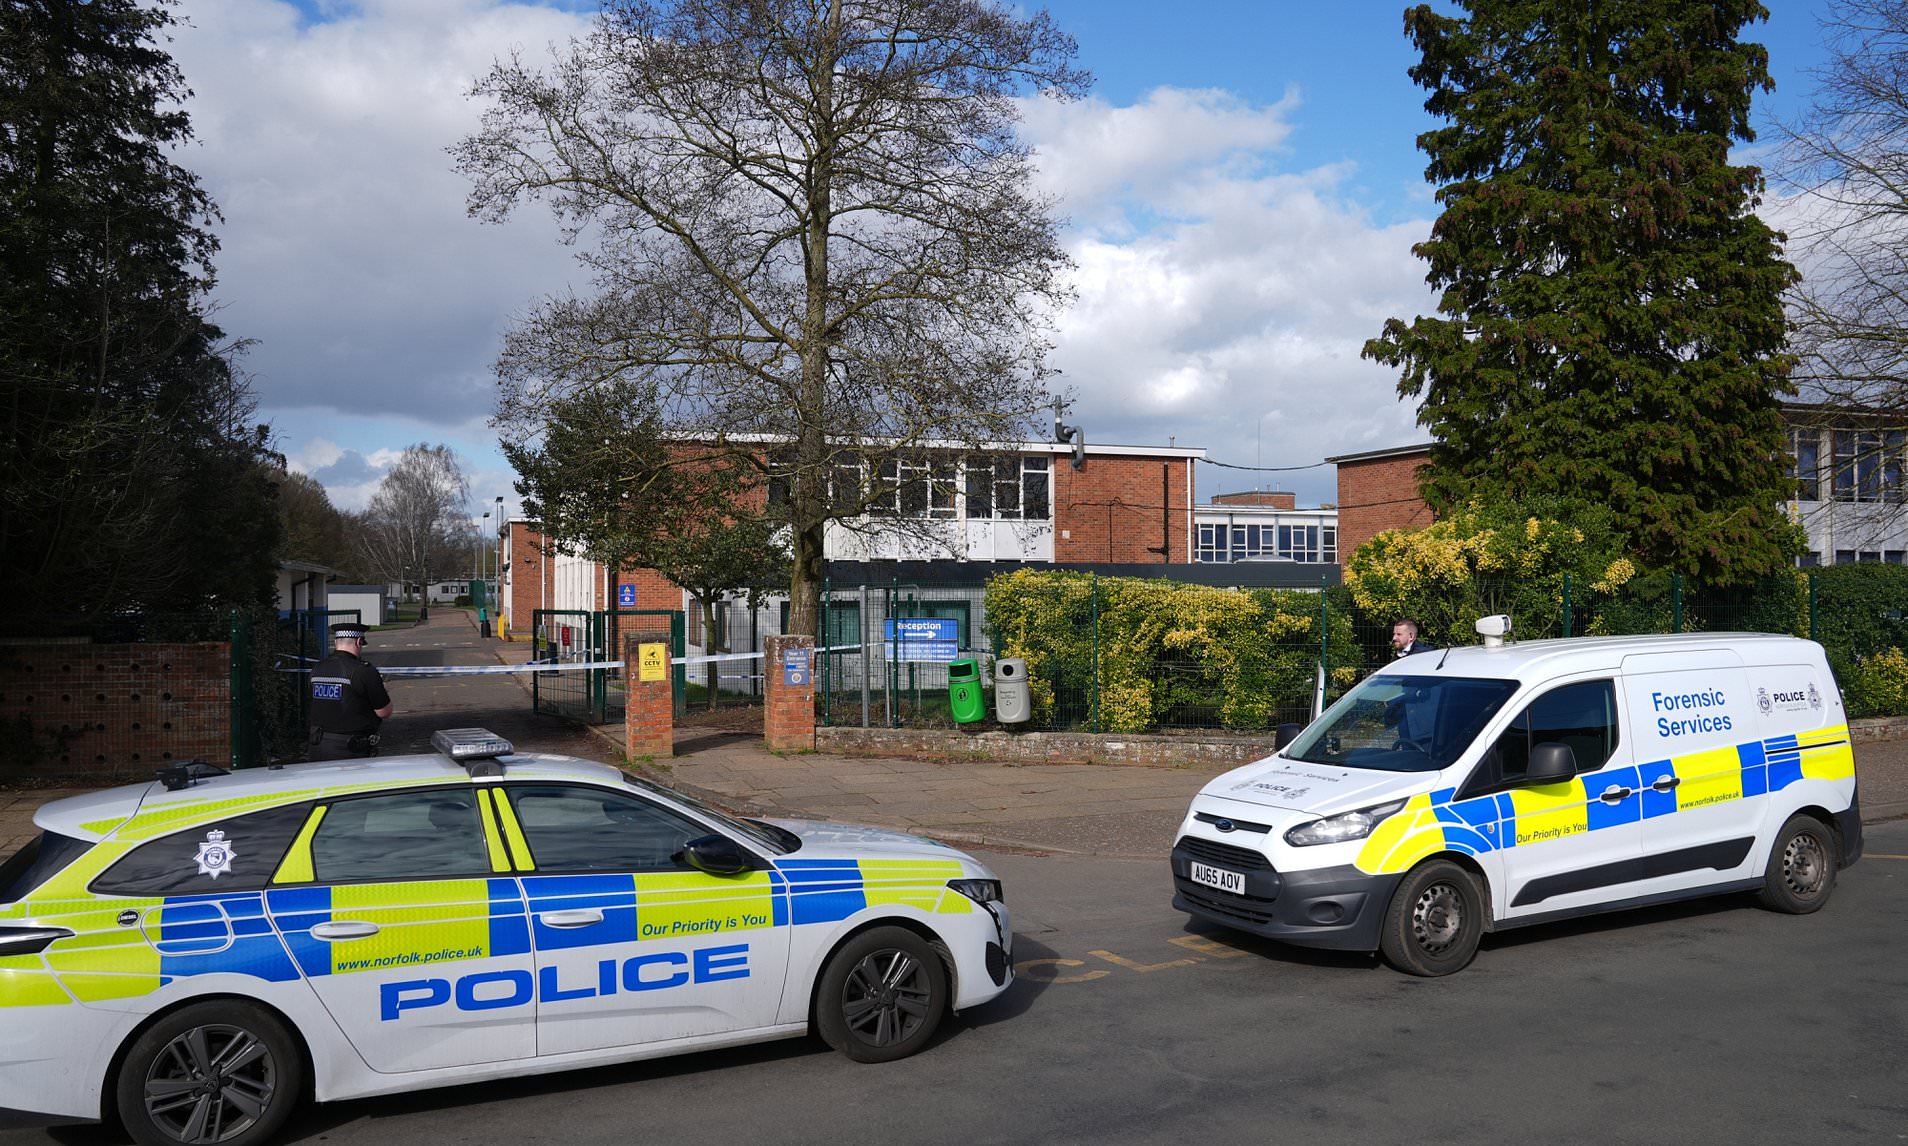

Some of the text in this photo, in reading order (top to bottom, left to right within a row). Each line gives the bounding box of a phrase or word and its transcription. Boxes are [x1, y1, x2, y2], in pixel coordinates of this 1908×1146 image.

[898, 622, 942, 631] Reception
[314, 684, 339, 698] POLICE
[1652, 687, 1725, 712] Forensic
[1773, 691, 1805, 703] POLICE
[1657, 714, 1732, 737] Services
[1680, 791, 1740, 809] www.norfolk.police.uk
[1517, 823, 1587, 843] Our Priority is You
[1195, 865, 1240, 891] AU65 AOV
[642, 914, 767, 936] Our Priority is You
[337, 946, 482, 971] www.norfolk.police.uk
[1014, 934, 1250, 984] CLE
[380, 944, 750, 1021] POLICE
